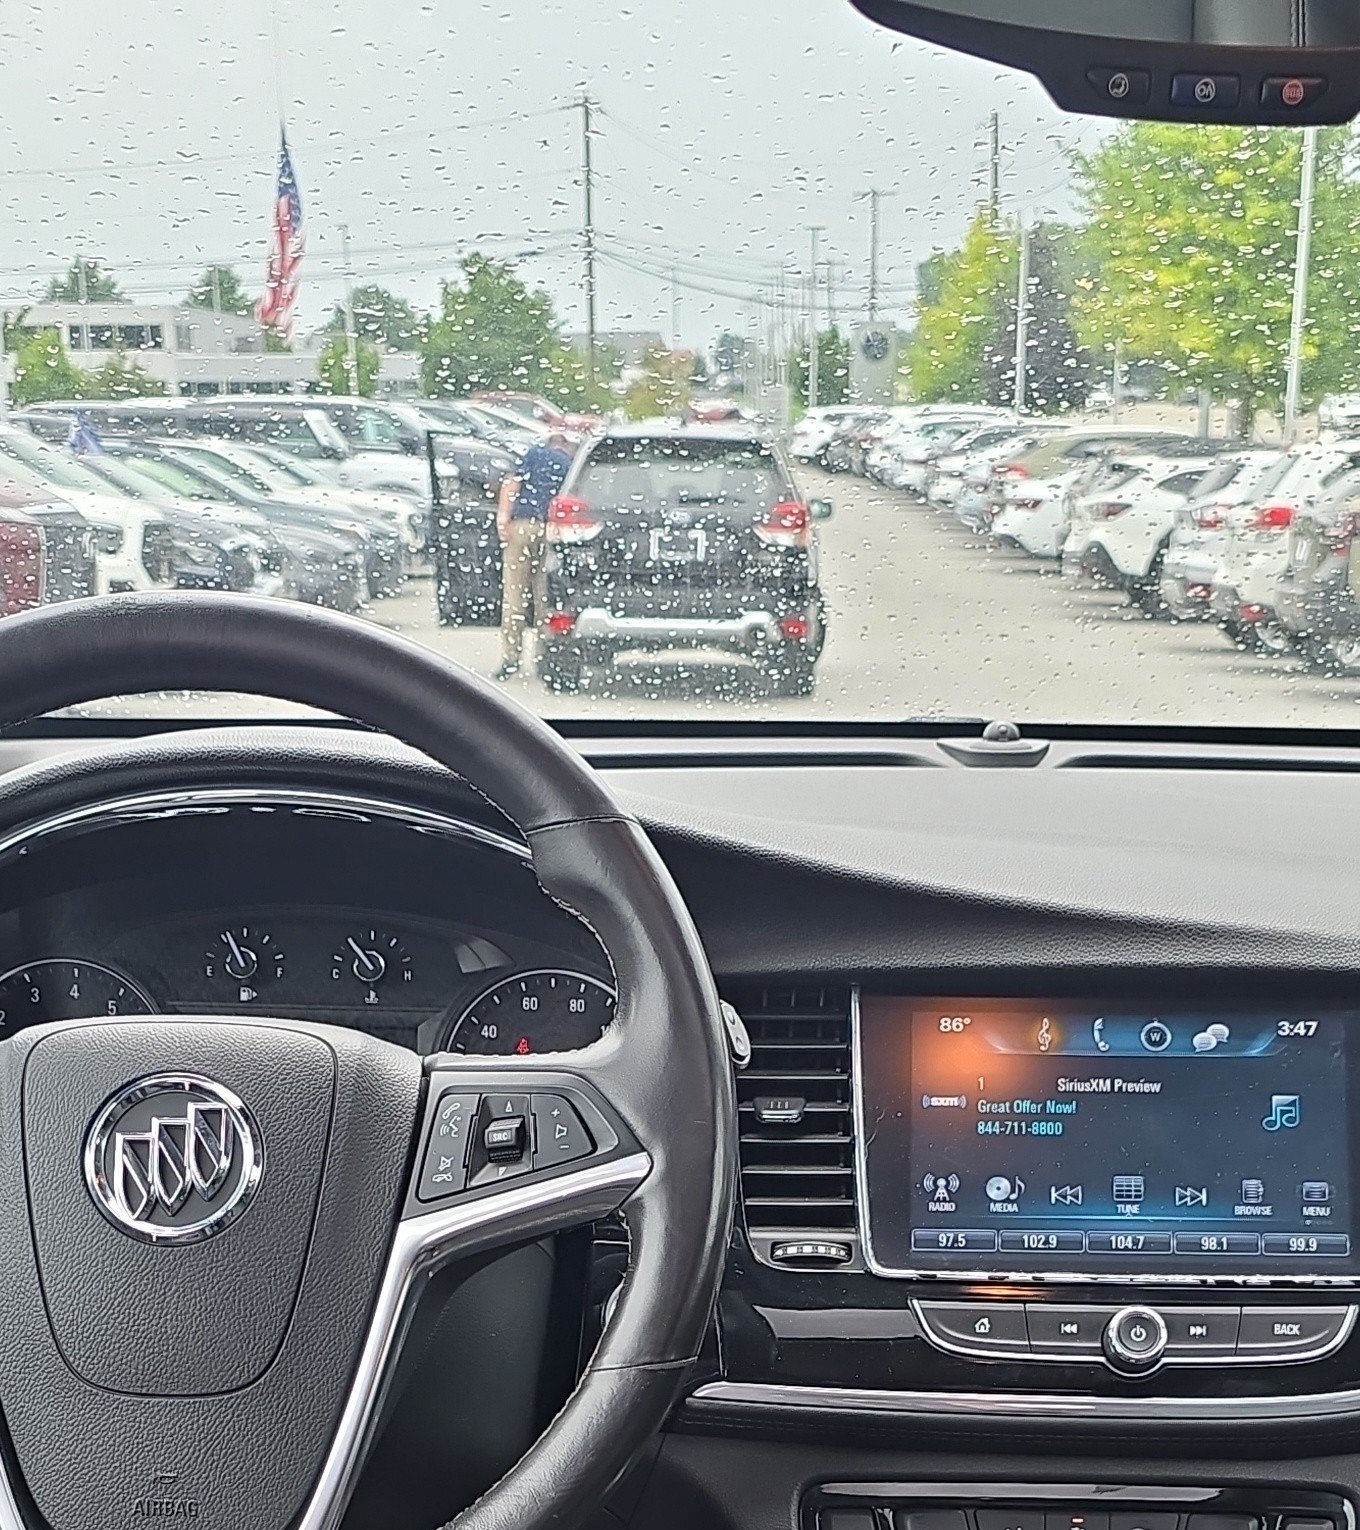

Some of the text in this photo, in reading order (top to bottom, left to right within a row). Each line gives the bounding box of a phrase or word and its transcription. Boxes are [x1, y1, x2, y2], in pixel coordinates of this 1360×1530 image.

[206, 965, 214, 977] E
[276, 966, 284, 978] F
[332, 967, 340, 980] C
[403, 969, 413, 981] H
[30, 987, 40, 1003] 3
[69, 984, 80, 999] 4
[107, 1000, 118, 1016] 5
[522, 997, 538, 1011] 60
[569, 998, 585, 1013] 80
[481, 1025, 498, 1039] 40
[1277, 1020, 1320, 1037] 3:47
[1150, 1032, 1161, 1043] W
[977, 1076, 984, 1091] 1
[1056, 1077, 1162, 1094] SiriusXM Preview
[977, 1100, 1077, 1115] Great Offer Now!
[977, 1120, 1064, 1136] 844-711-8800
[928, 1202, 956, 1212] RADIO
[989, 1203, 1019, 1213] MEDIA
[1116, 1204, 1141, 1214] TUNE
[1234, 1206, 1273, 1216] BROWSE
[1302, 1207, 1331, 1217] MENU
[938, 1233, 967, 1247] 97.5
[1022, 1234, 1058, 1248] 102.9
[1109, 1236, 1145, 1250] 104.7
[1200, 1237, 1229, 1251] 98.1
[1289, 1238, 1318, 1252] 99.9
[1273, 1322, 1300, 1336] BACK
[131, 1499, 200, 1518] AIRBAG
